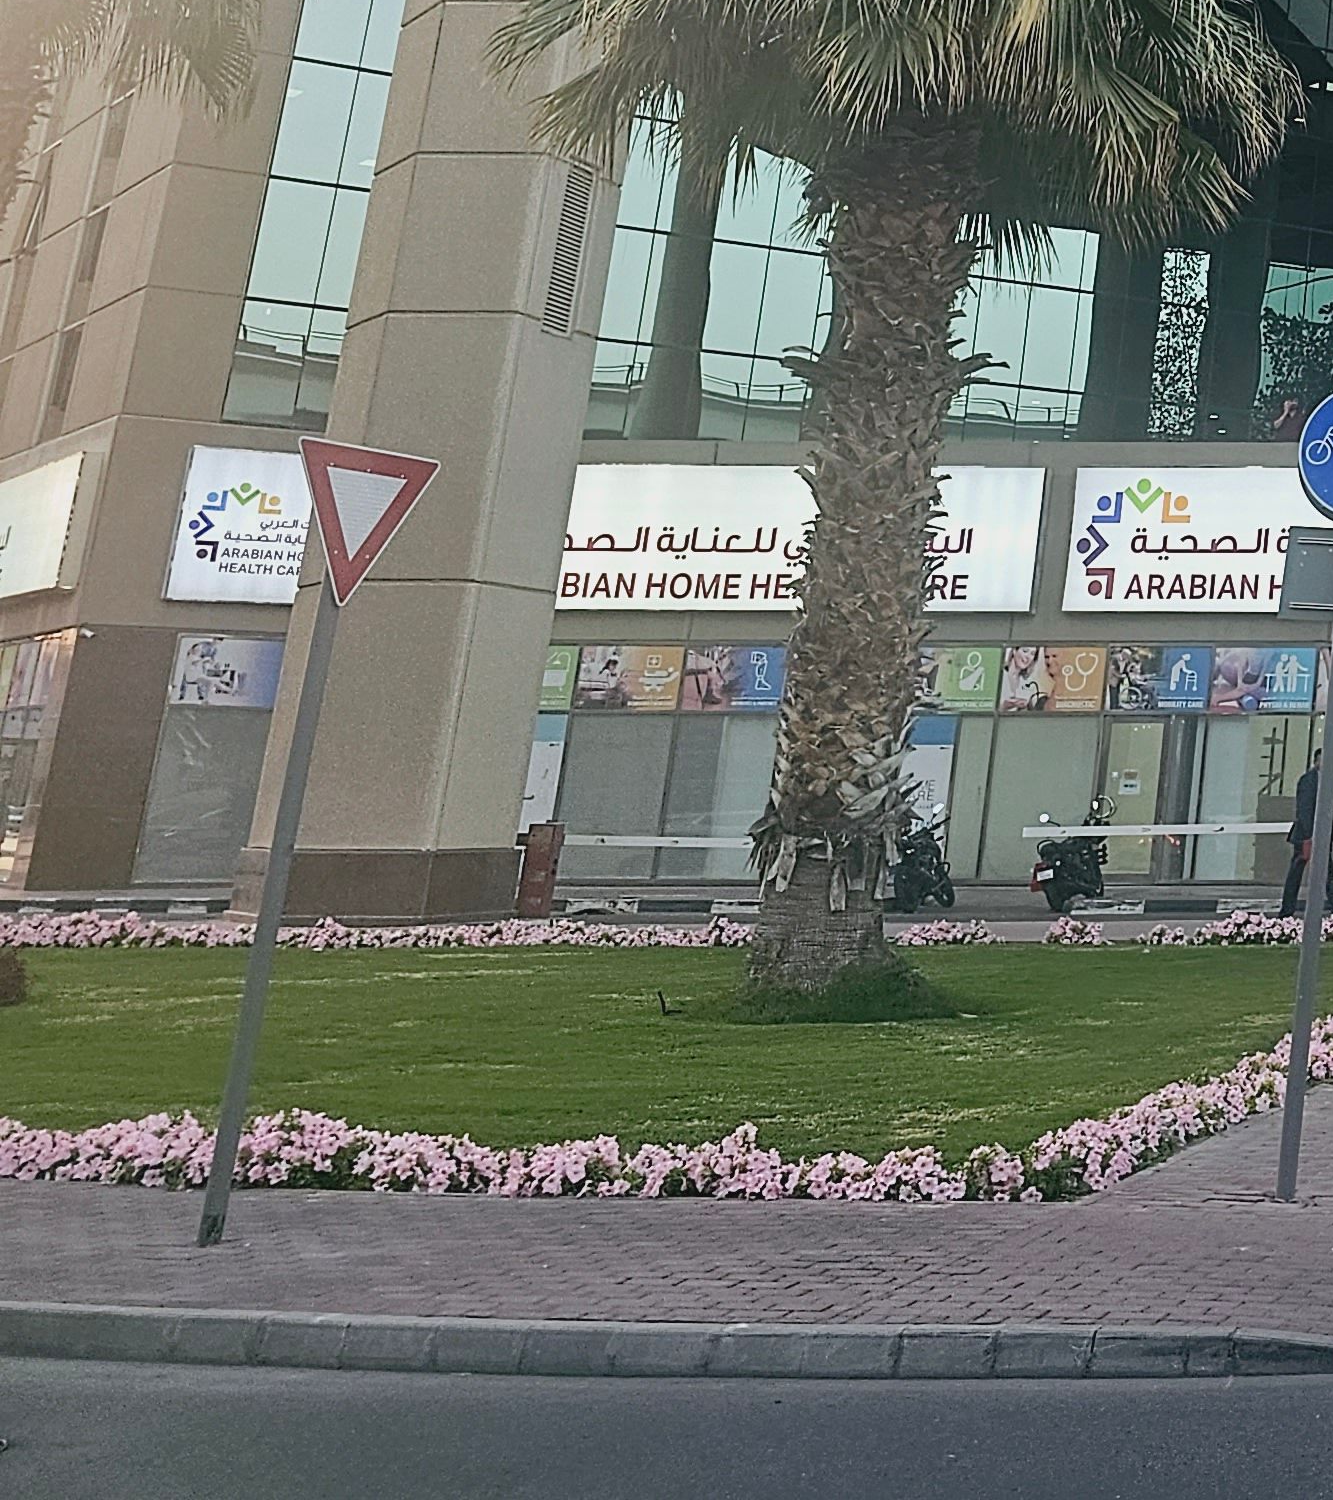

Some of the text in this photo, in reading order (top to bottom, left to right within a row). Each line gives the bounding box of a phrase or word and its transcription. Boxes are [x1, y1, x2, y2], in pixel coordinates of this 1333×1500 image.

[223, 530, 282, 544] الصحية
[656, 526, 778, 560] للعناية
[1130, 527, 1270, 561] الصحية
[221, 547, 305, 562] ARABIAN HO
[218, 562, 301, 576] HEALTH CAR
[560, 572, 637, 599] BIAN
[645, 572, 742, 600] HOME
[930, 574, 969, 600] RE
[1123, 573, 1260, 600] ARABIAN
